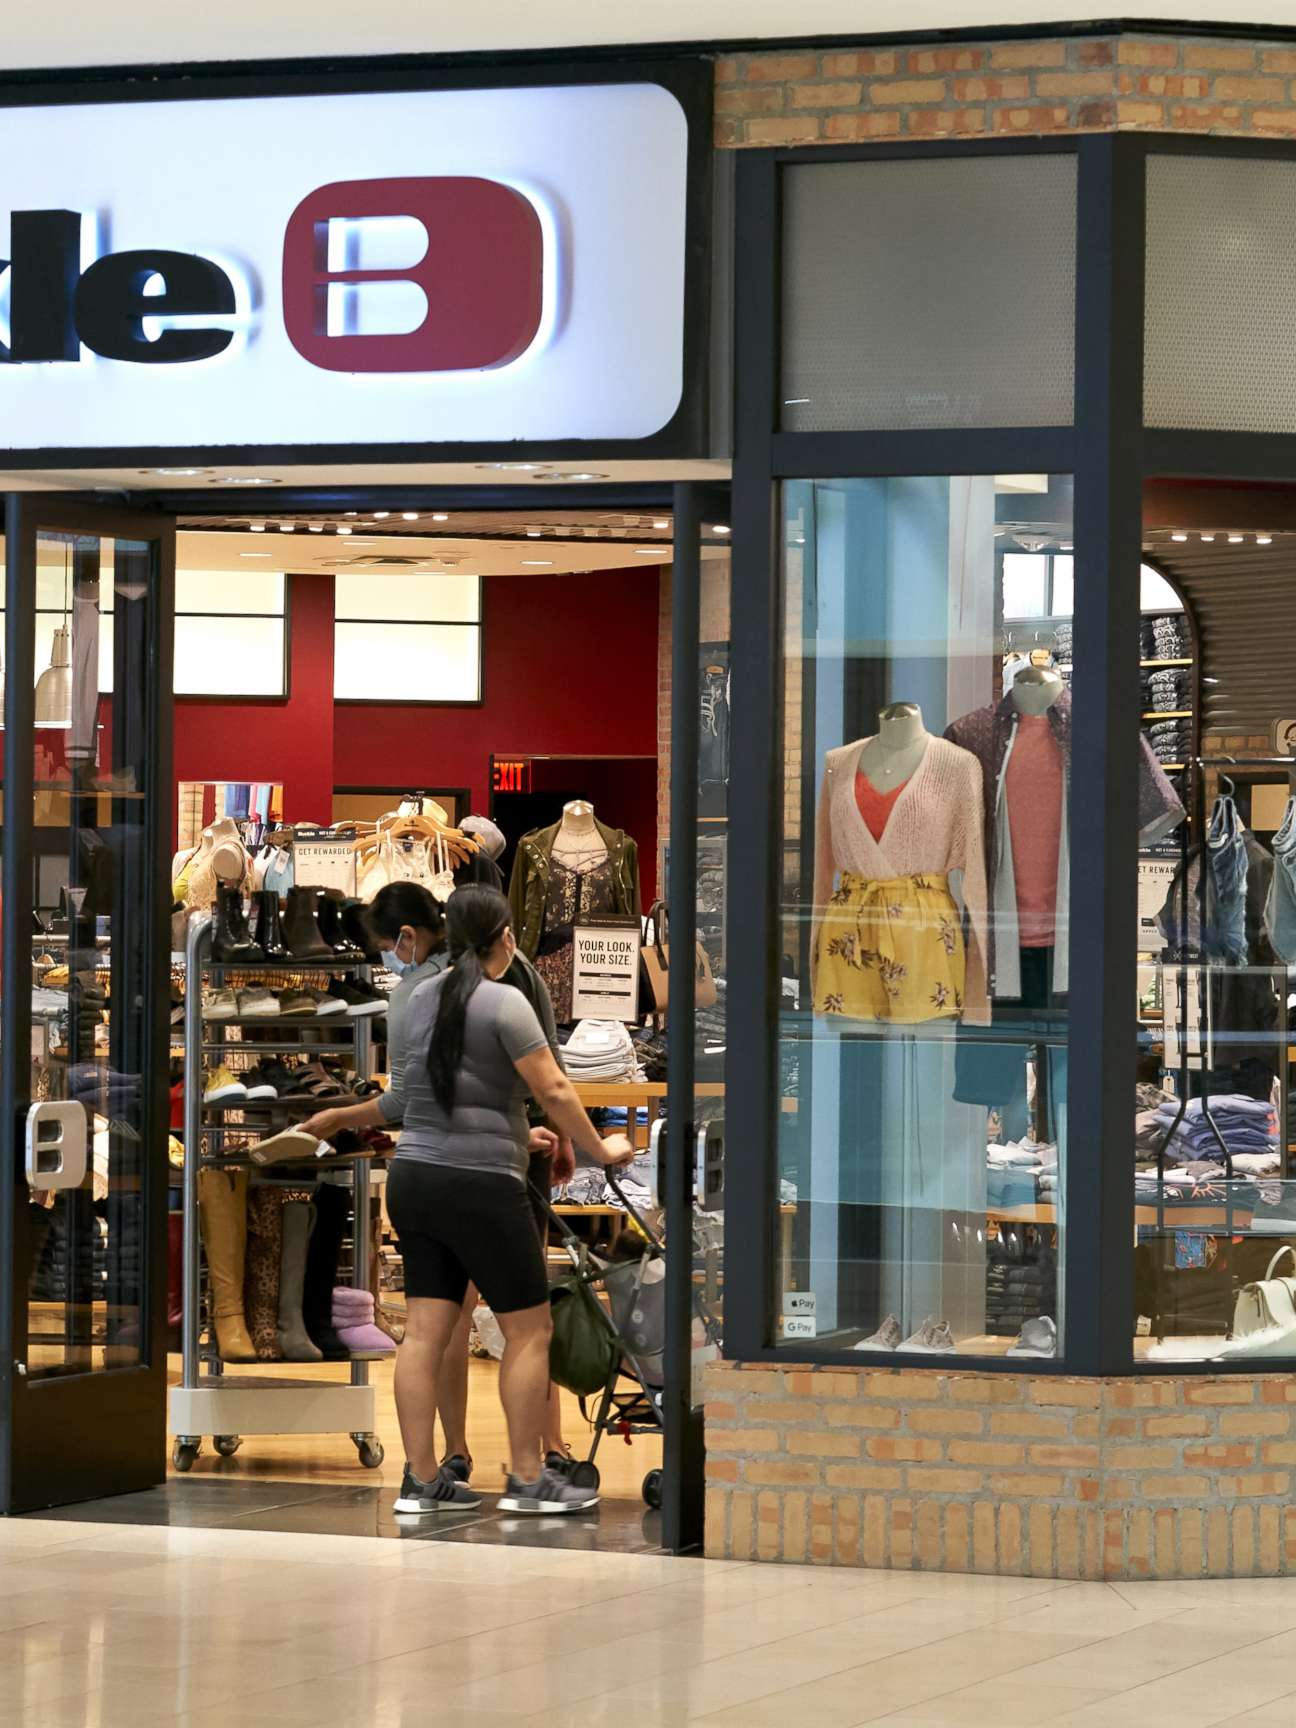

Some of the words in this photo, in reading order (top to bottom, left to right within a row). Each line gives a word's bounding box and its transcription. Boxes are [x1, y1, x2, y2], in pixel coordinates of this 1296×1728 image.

[493, 762, 525, 791] EXIT
[298, 848, 311, 856] GET
[314, 848, 351, 856] REWARDED
[578, 940, 604, 952] YOUR
[607, 941, 635, 953] LOOK.
[580, 953, 606, 965] YOUR
[608, 954, 633, 966] SIZE.
[798, 1299, 815, 1310] Pay
[797, 1322, 812, 1333] Pay
